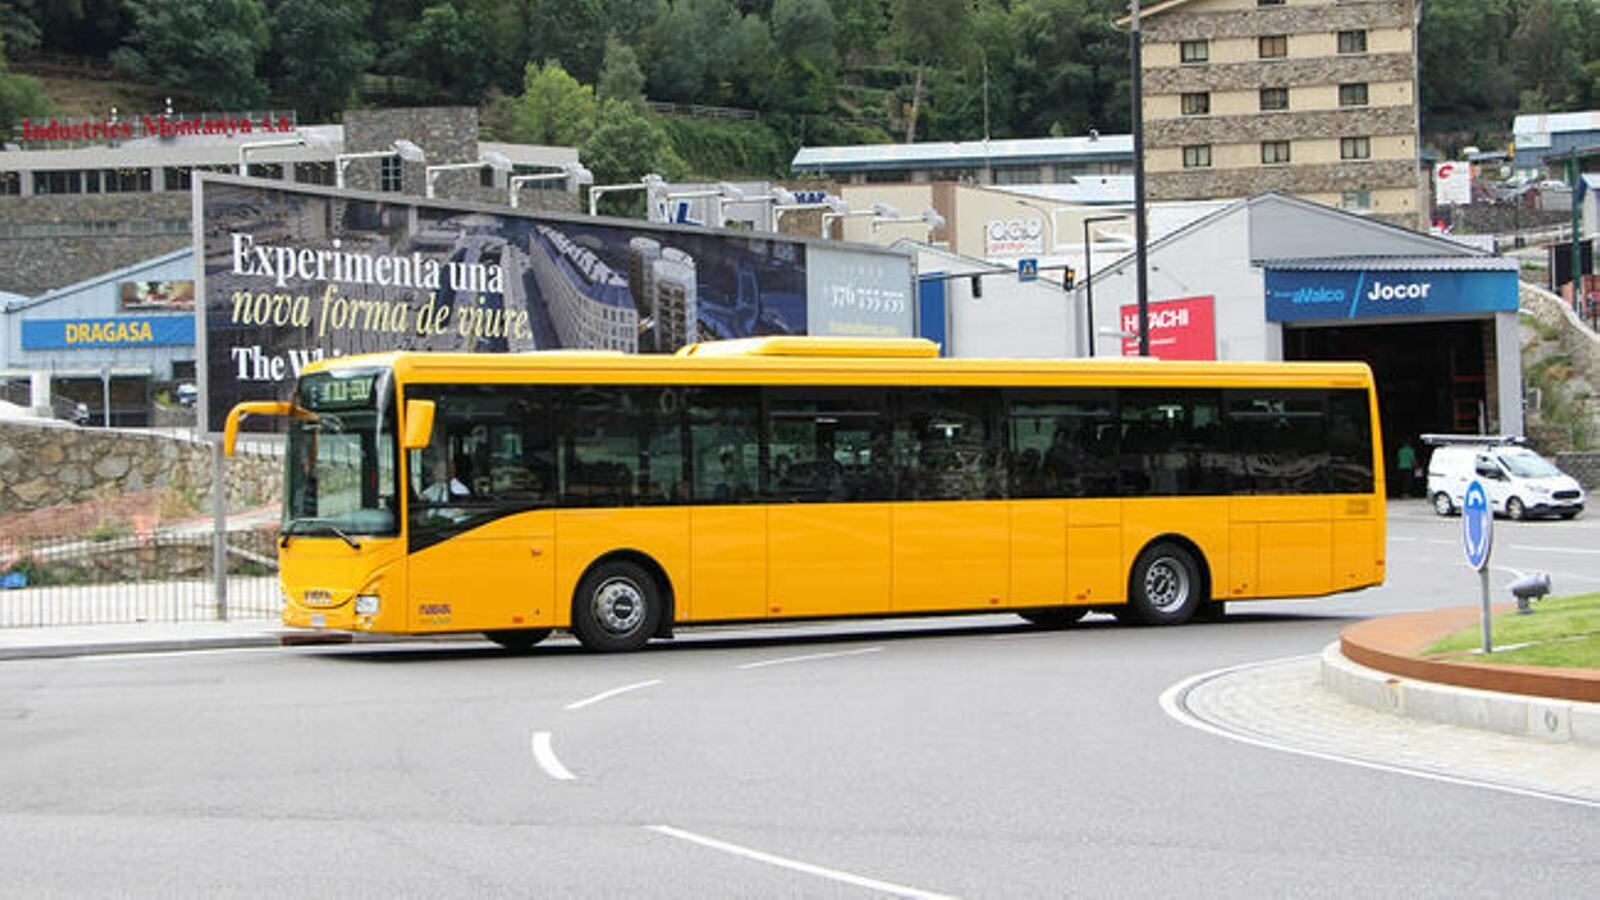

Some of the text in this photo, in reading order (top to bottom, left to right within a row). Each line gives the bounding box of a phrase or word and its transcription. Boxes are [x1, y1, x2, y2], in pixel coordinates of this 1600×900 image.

[143, 116, 252, 139] Montanya
[231, 232, 504, 293] Experimenta una
[1367, 281, 1431, 300] Jocor
[230, 290, 311, 328] nova
[318, 284, 408, 338] forma
[415, 294, 450, 334] de
[1124, 308, 1190, 332] HACHI
[65, 321, 153, 343] DRAGASA
[231, 345, 286, 381] The
